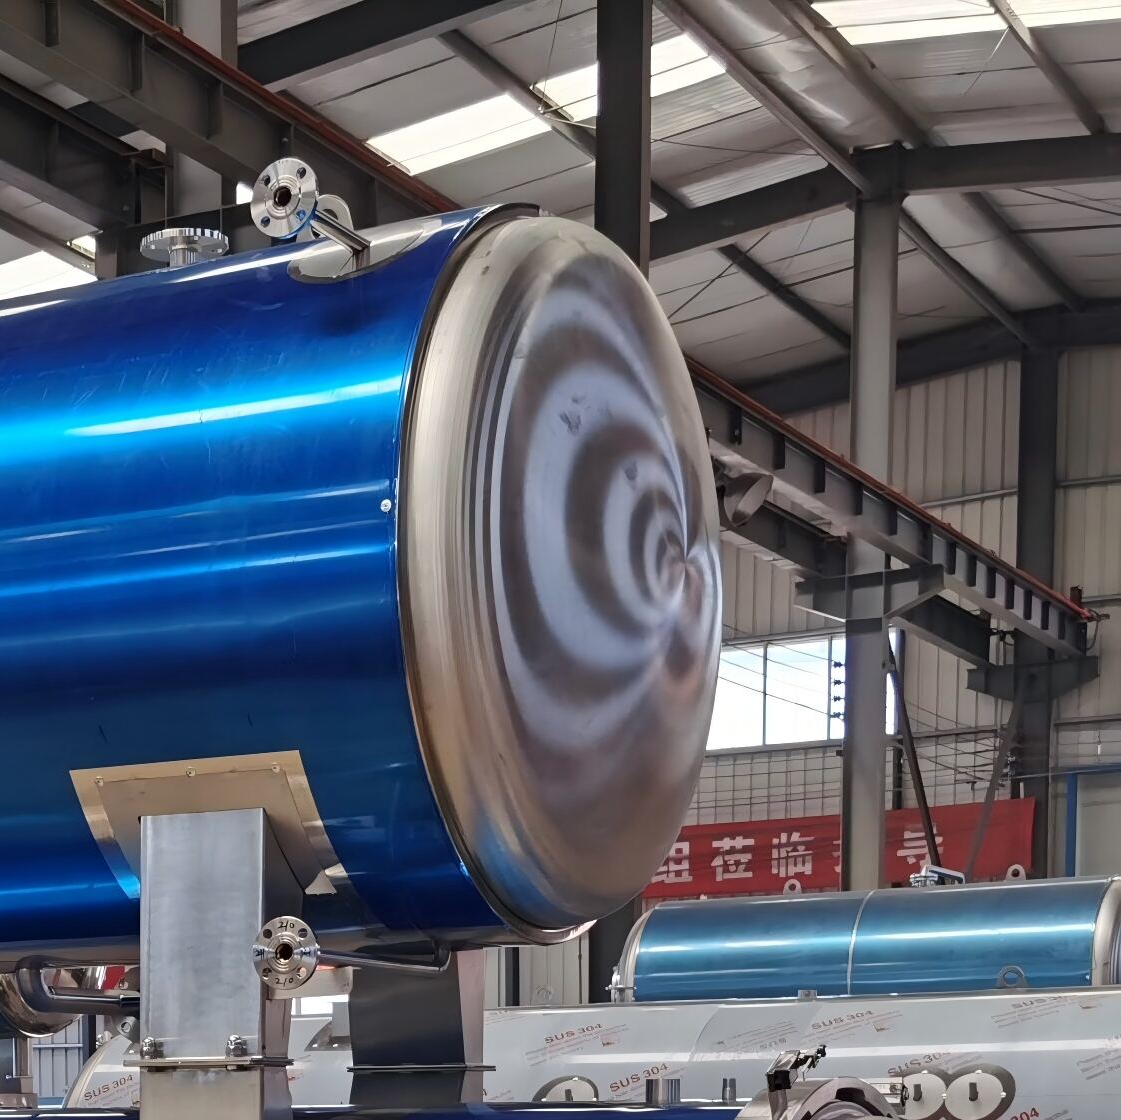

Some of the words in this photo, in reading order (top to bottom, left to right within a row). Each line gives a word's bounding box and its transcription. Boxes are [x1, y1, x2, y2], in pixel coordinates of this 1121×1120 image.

[651, 823, 943, 884] 组莅临导
[544, 1030, 575, 1044] SUS
[578, 1023, 603, 1035] 304
[812, 1016, 844, 1030] SUS
[846, 1010, 874, 1022] 304
[84, 1084, 110, 1101] SUS
[112, 1074, 134, 1089] 304
[609, 1073, 641, 1092] SUS
[643, 1062, 669, 1079] 304
